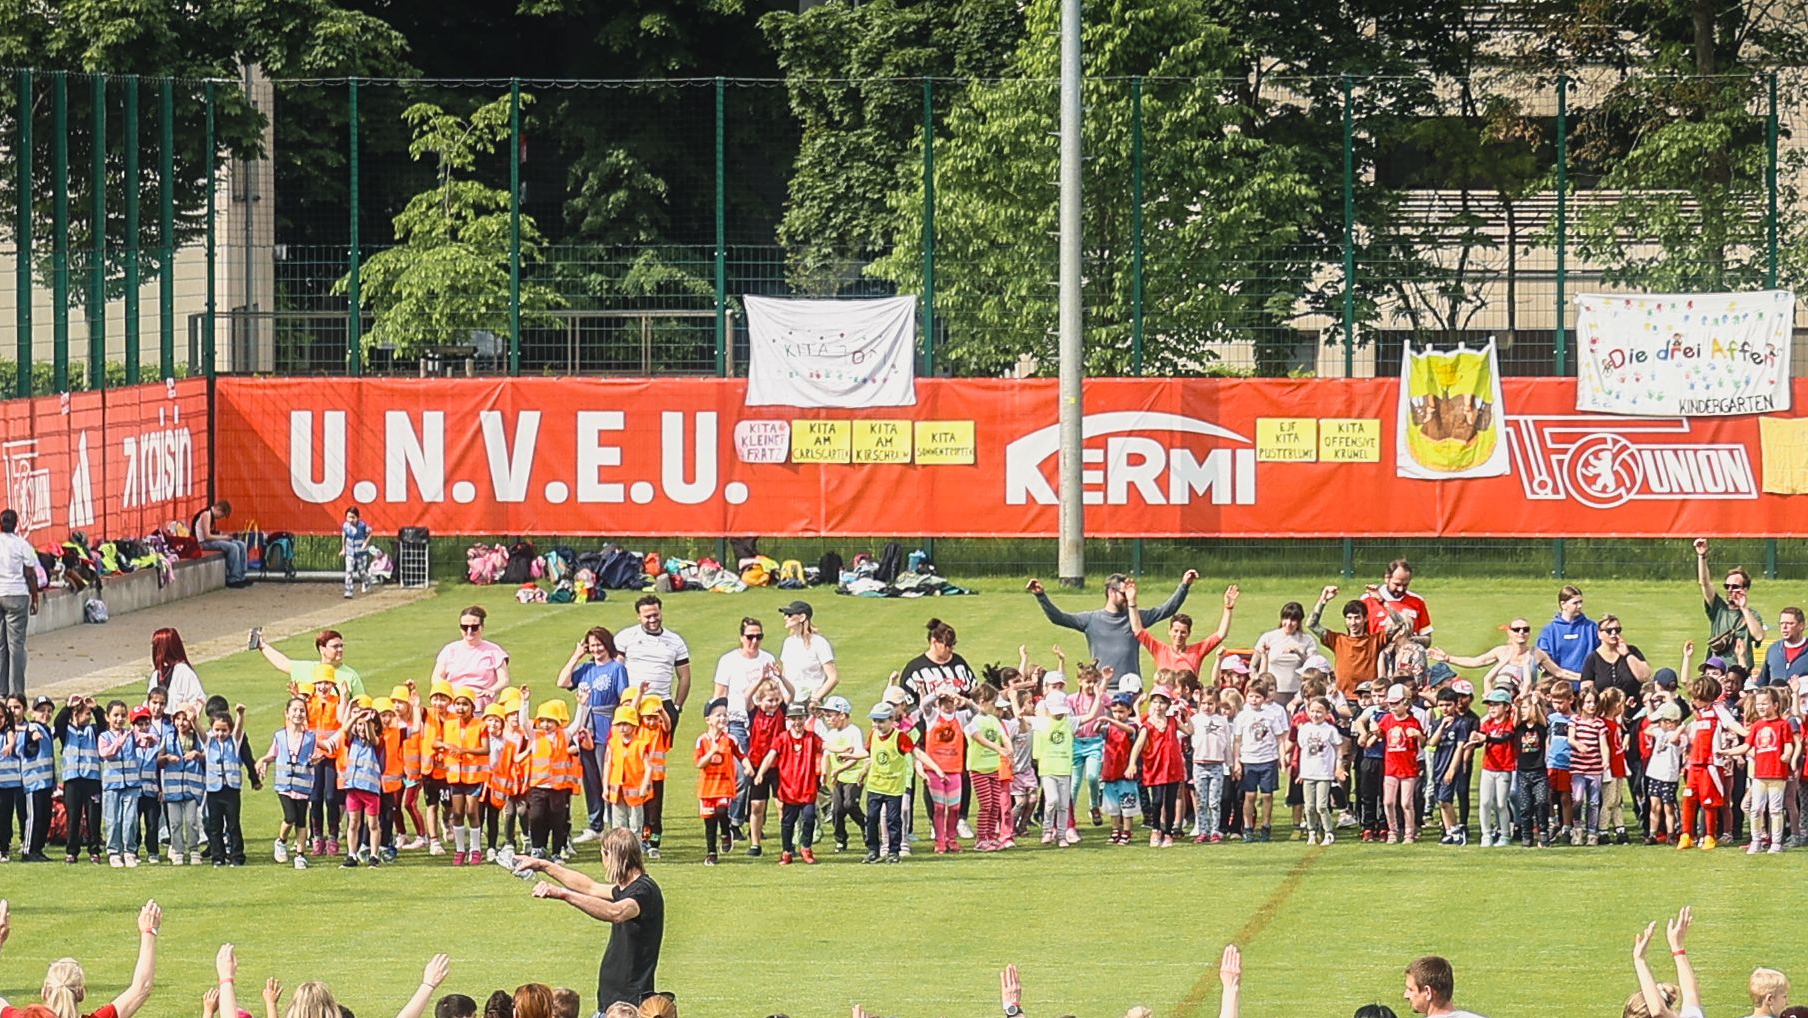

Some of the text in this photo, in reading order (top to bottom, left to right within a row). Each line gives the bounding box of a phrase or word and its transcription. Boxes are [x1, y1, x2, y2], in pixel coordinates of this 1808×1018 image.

[1608, 336, 1777, 369] Die drei Affen
[1678, 394, 1776, 415] KINDERGARTEN
[749, 423, 777, 433] KITA
[809, 423, 836, 434] KITA
[870, 423, 898, 434] KITA
[1279, 422, 1296, 432] EJF
[1338, 423, 1365, 433] KITA
[814, 436, 832, 446] AM
[875, 437, 893, 447] AM
[931, 432, 956, 443] KITA
[1275, 433, 1300, 443] KITA
[139, 405, 193, 505] raisin
[290, 409, 749, 505] U.N.V.E.U.
[747, 448, 782, 461] FRATZ
[1005, 410, 1256, 507] KERMI
[1641, 449, 1752, 493] UNION
